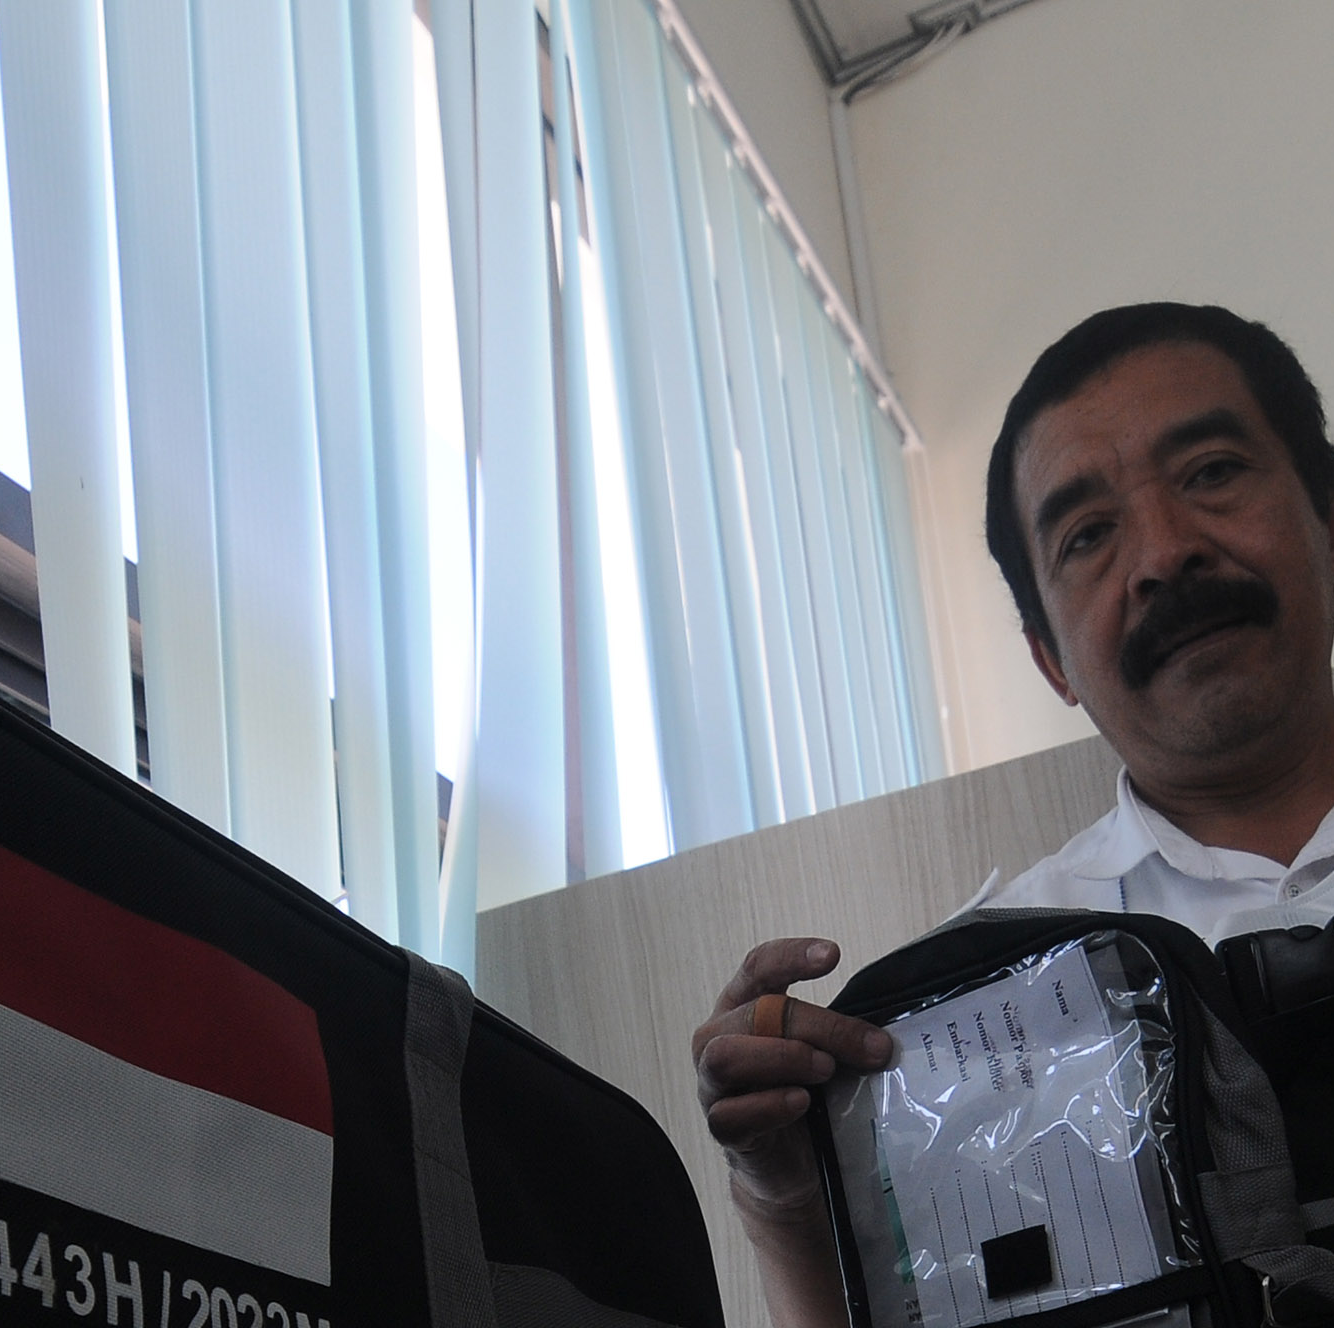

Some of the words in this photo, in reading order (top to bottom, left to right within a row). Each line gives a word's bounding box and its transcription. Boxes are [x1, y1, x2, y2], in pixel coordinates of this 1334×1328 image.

[1053, 980, 1069, 1016] Nama
[973, 1011, 991, 1053] Nomor
[1000, 1001, 1019, 1042] Nomor
[921, 1033, 938, 1073] Alamat
[947, 1021, 971, 1083] Embarkasi
